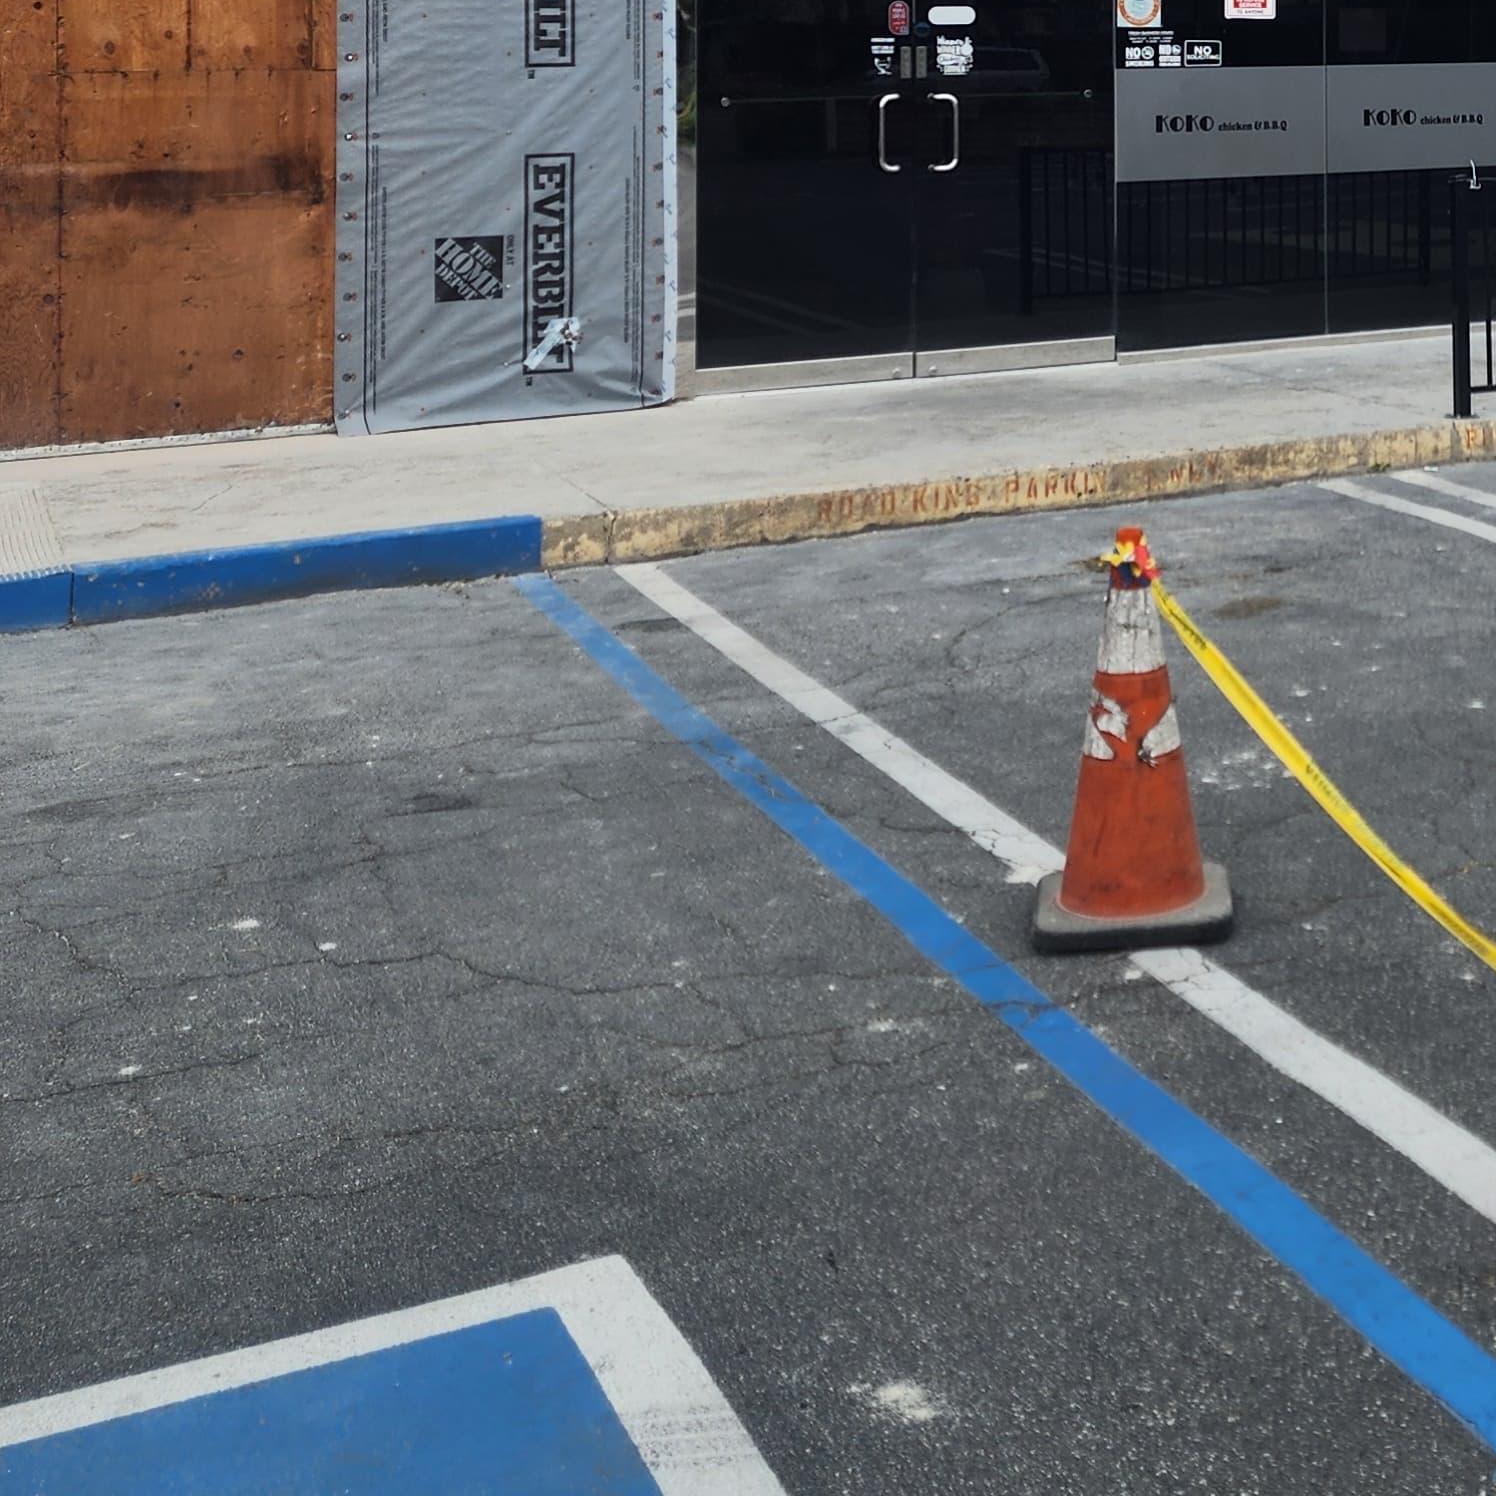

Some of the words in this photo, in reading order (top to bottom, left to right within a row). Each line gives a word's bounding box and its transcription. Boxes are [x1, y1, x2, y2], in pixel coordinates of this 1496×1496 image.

[1194, 46, 1212, 55] NO
[1155, 115, 1215, 133] KOKO
[1218, 122, 1252, 131] chicken
[1363, 109, 1417, 126] KOKO
[1420, 115, 1451, 124] chicken
[471, 241, 496, 265] THE
[435, 238, 504, 302] HOME
[435, 263, 480, 301] DEPOT
